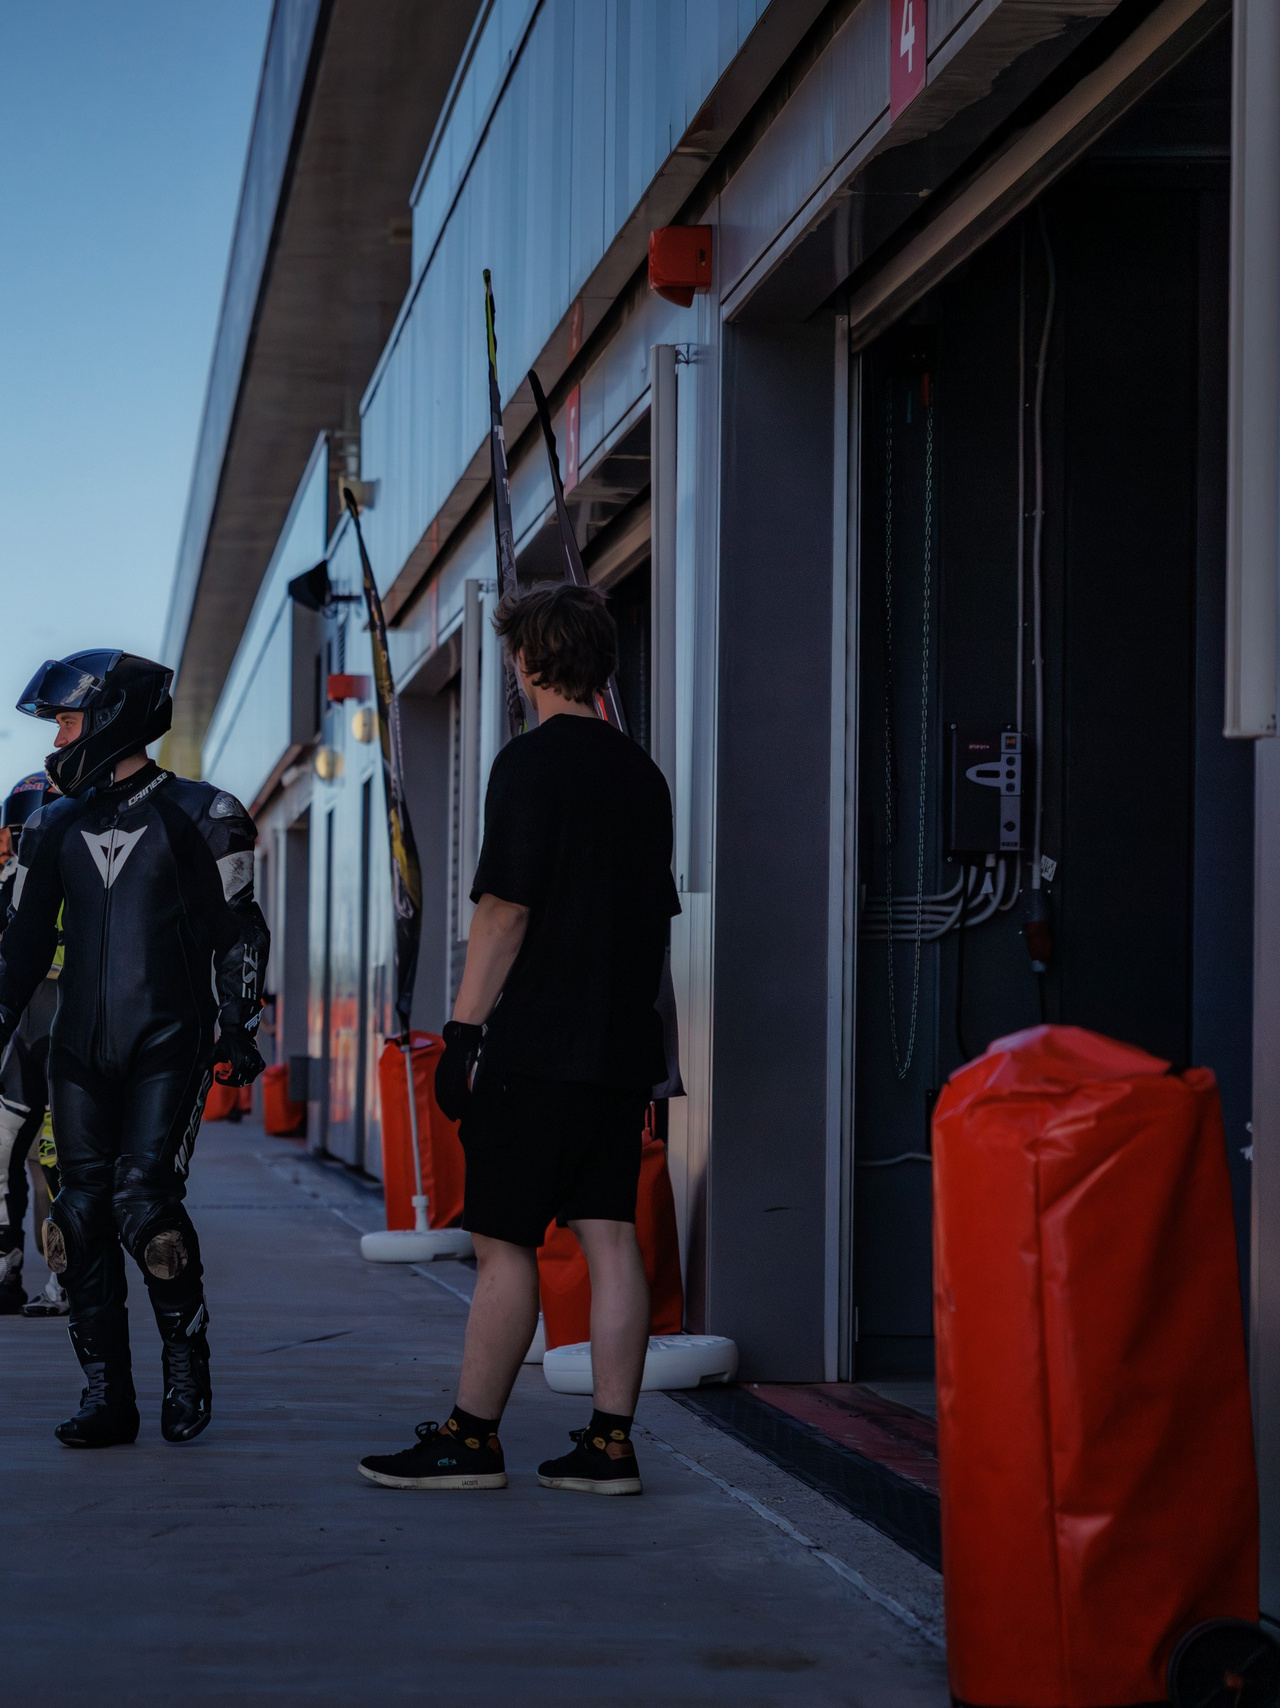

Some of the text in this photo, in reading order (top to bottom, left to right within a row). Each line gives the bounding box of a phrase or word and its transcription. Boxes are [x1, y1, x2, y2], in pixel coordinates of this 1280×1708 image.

[900, 0, 915, 73] 4
[569, 406, 576, 474] 5
[128, 771, 169, 807] DAINESE
